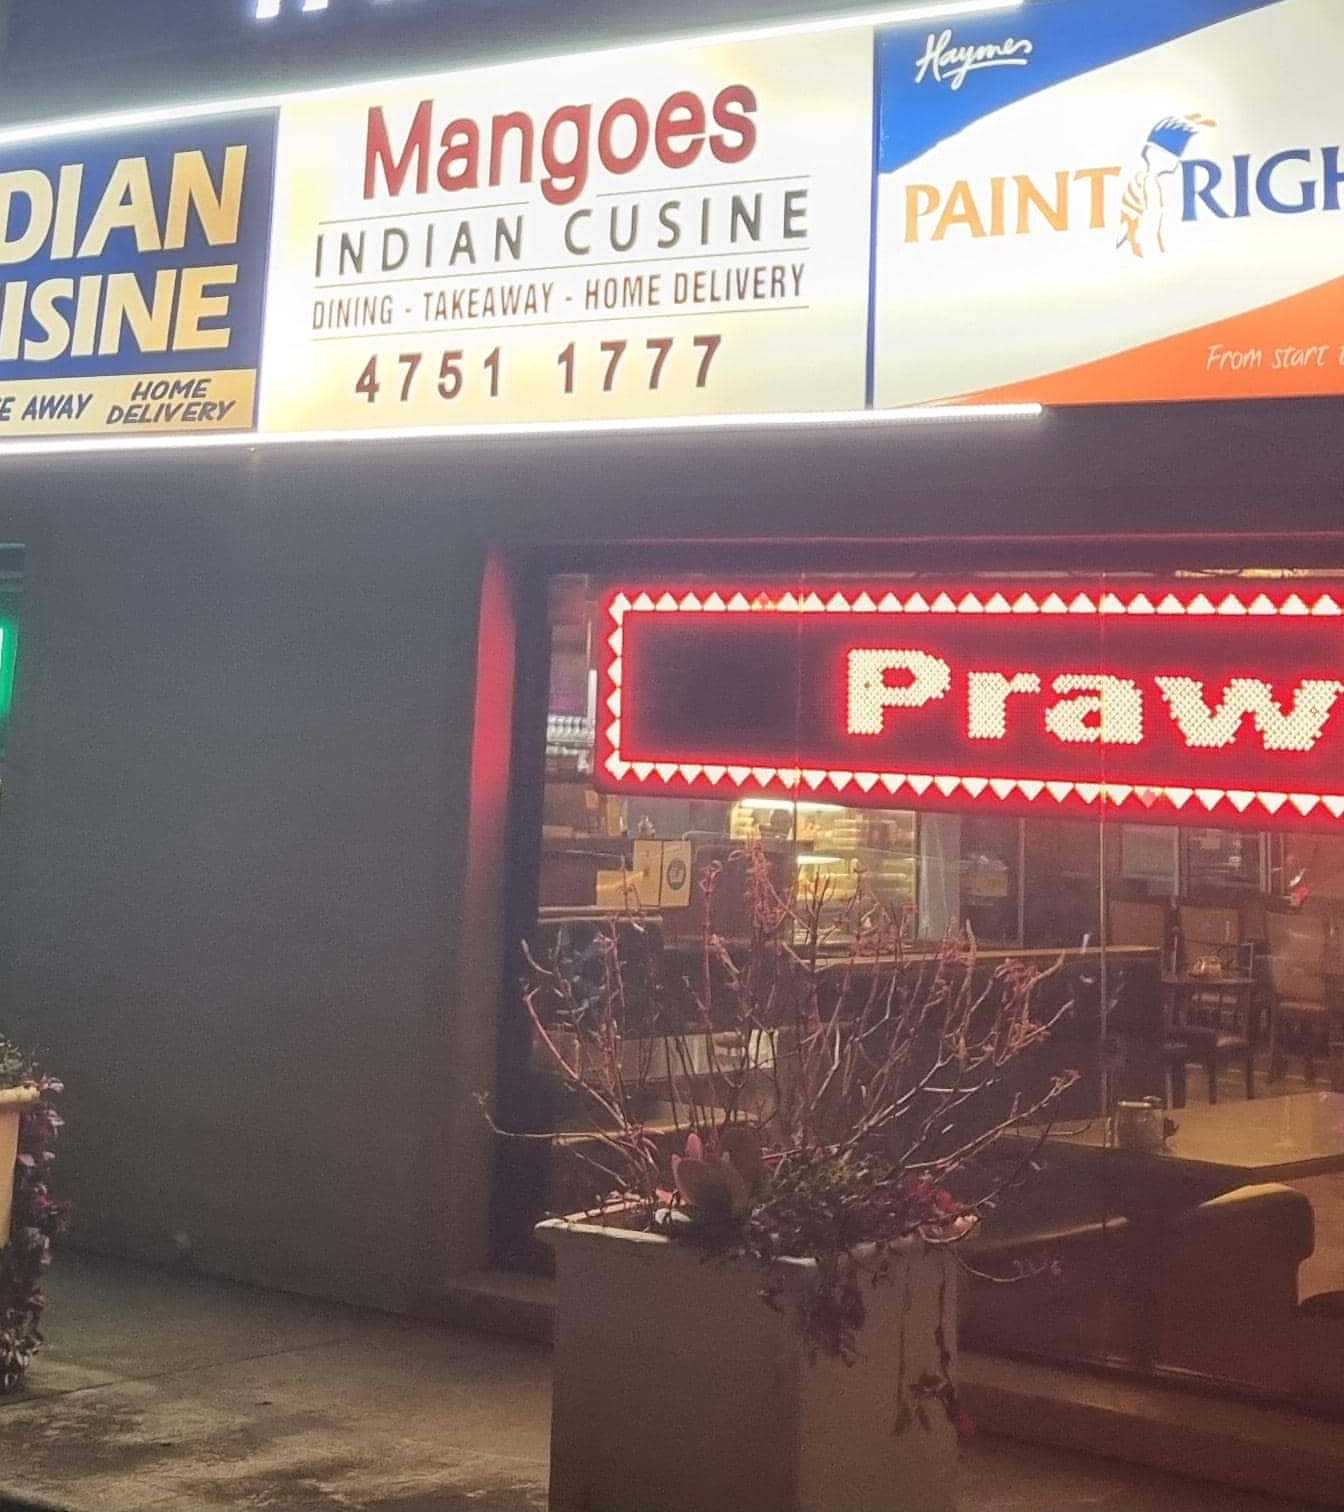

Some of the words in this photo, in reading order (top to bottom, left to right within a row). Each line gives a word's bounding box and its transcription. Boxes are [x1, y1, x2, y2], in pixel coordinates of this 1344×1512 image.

[914, 29, 1032, 90] Haymes
[363, 84, 757, 205] Mangoes
[314, 215, 524, 278] INDIAN
[564, 189, 809, 255] CUSINE
[904, 166, 1121, 243] PAINT
[312, 295, 393, 330] DINING
[423, 282, 554, 323] TAKEAWAY
[586, 274, 661, 311] HOME
[673, 263, 805, 305] DELIVERY
[131, 378, 211, 401] HOME
[356, 347, 502, 403] 4751
[558, 335, 723, 395] 1777
[1206, 344, 1262, 371] From
[1272, 344, 1330, 370] start
[21, 393, 92, 421] AWAY
[106, 399, 236, 425] DELIVERY
